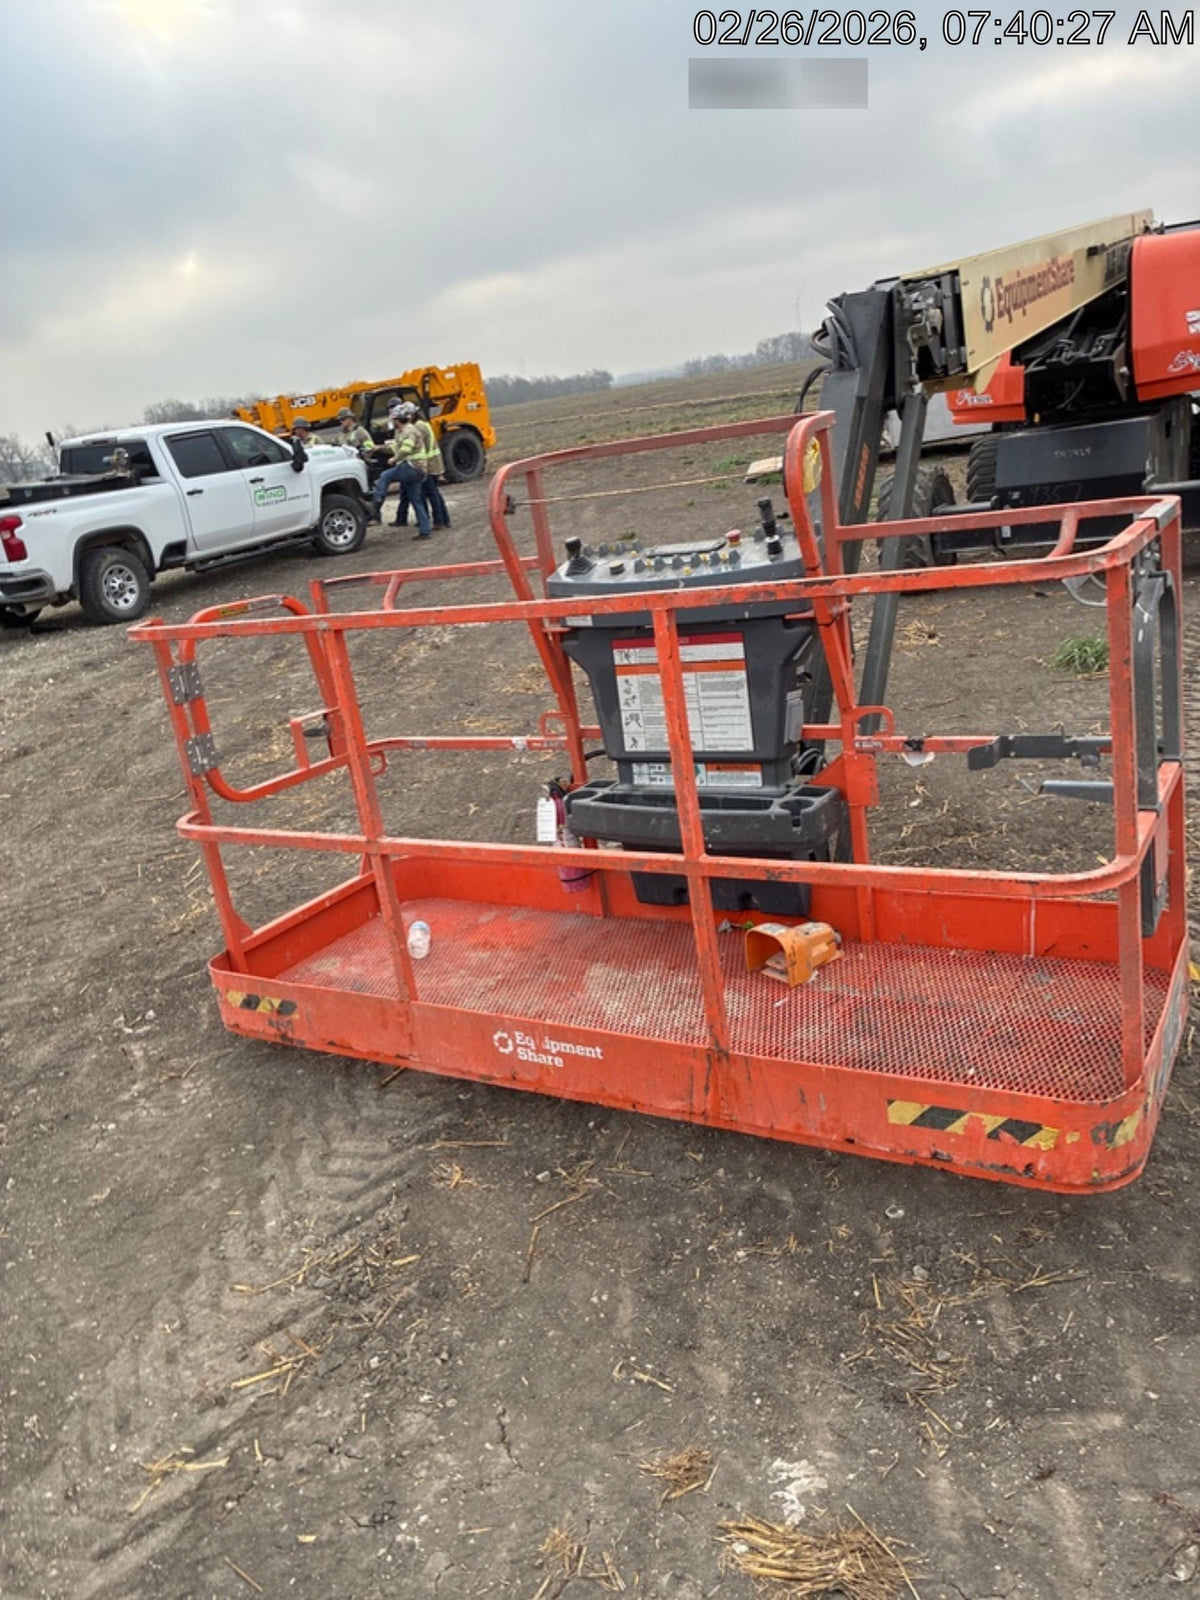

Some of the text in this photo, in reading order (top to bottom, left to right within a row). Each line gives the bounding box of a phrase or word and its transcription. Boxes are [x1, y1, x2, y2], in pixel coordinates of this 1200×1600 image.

[995, 256, 1074, 323] EquipmentShare
[290, 396, 317, 408] JCB
[514, 1030, 605, 1059] Eqipment
[516, 1046, 565, 1068] Share
